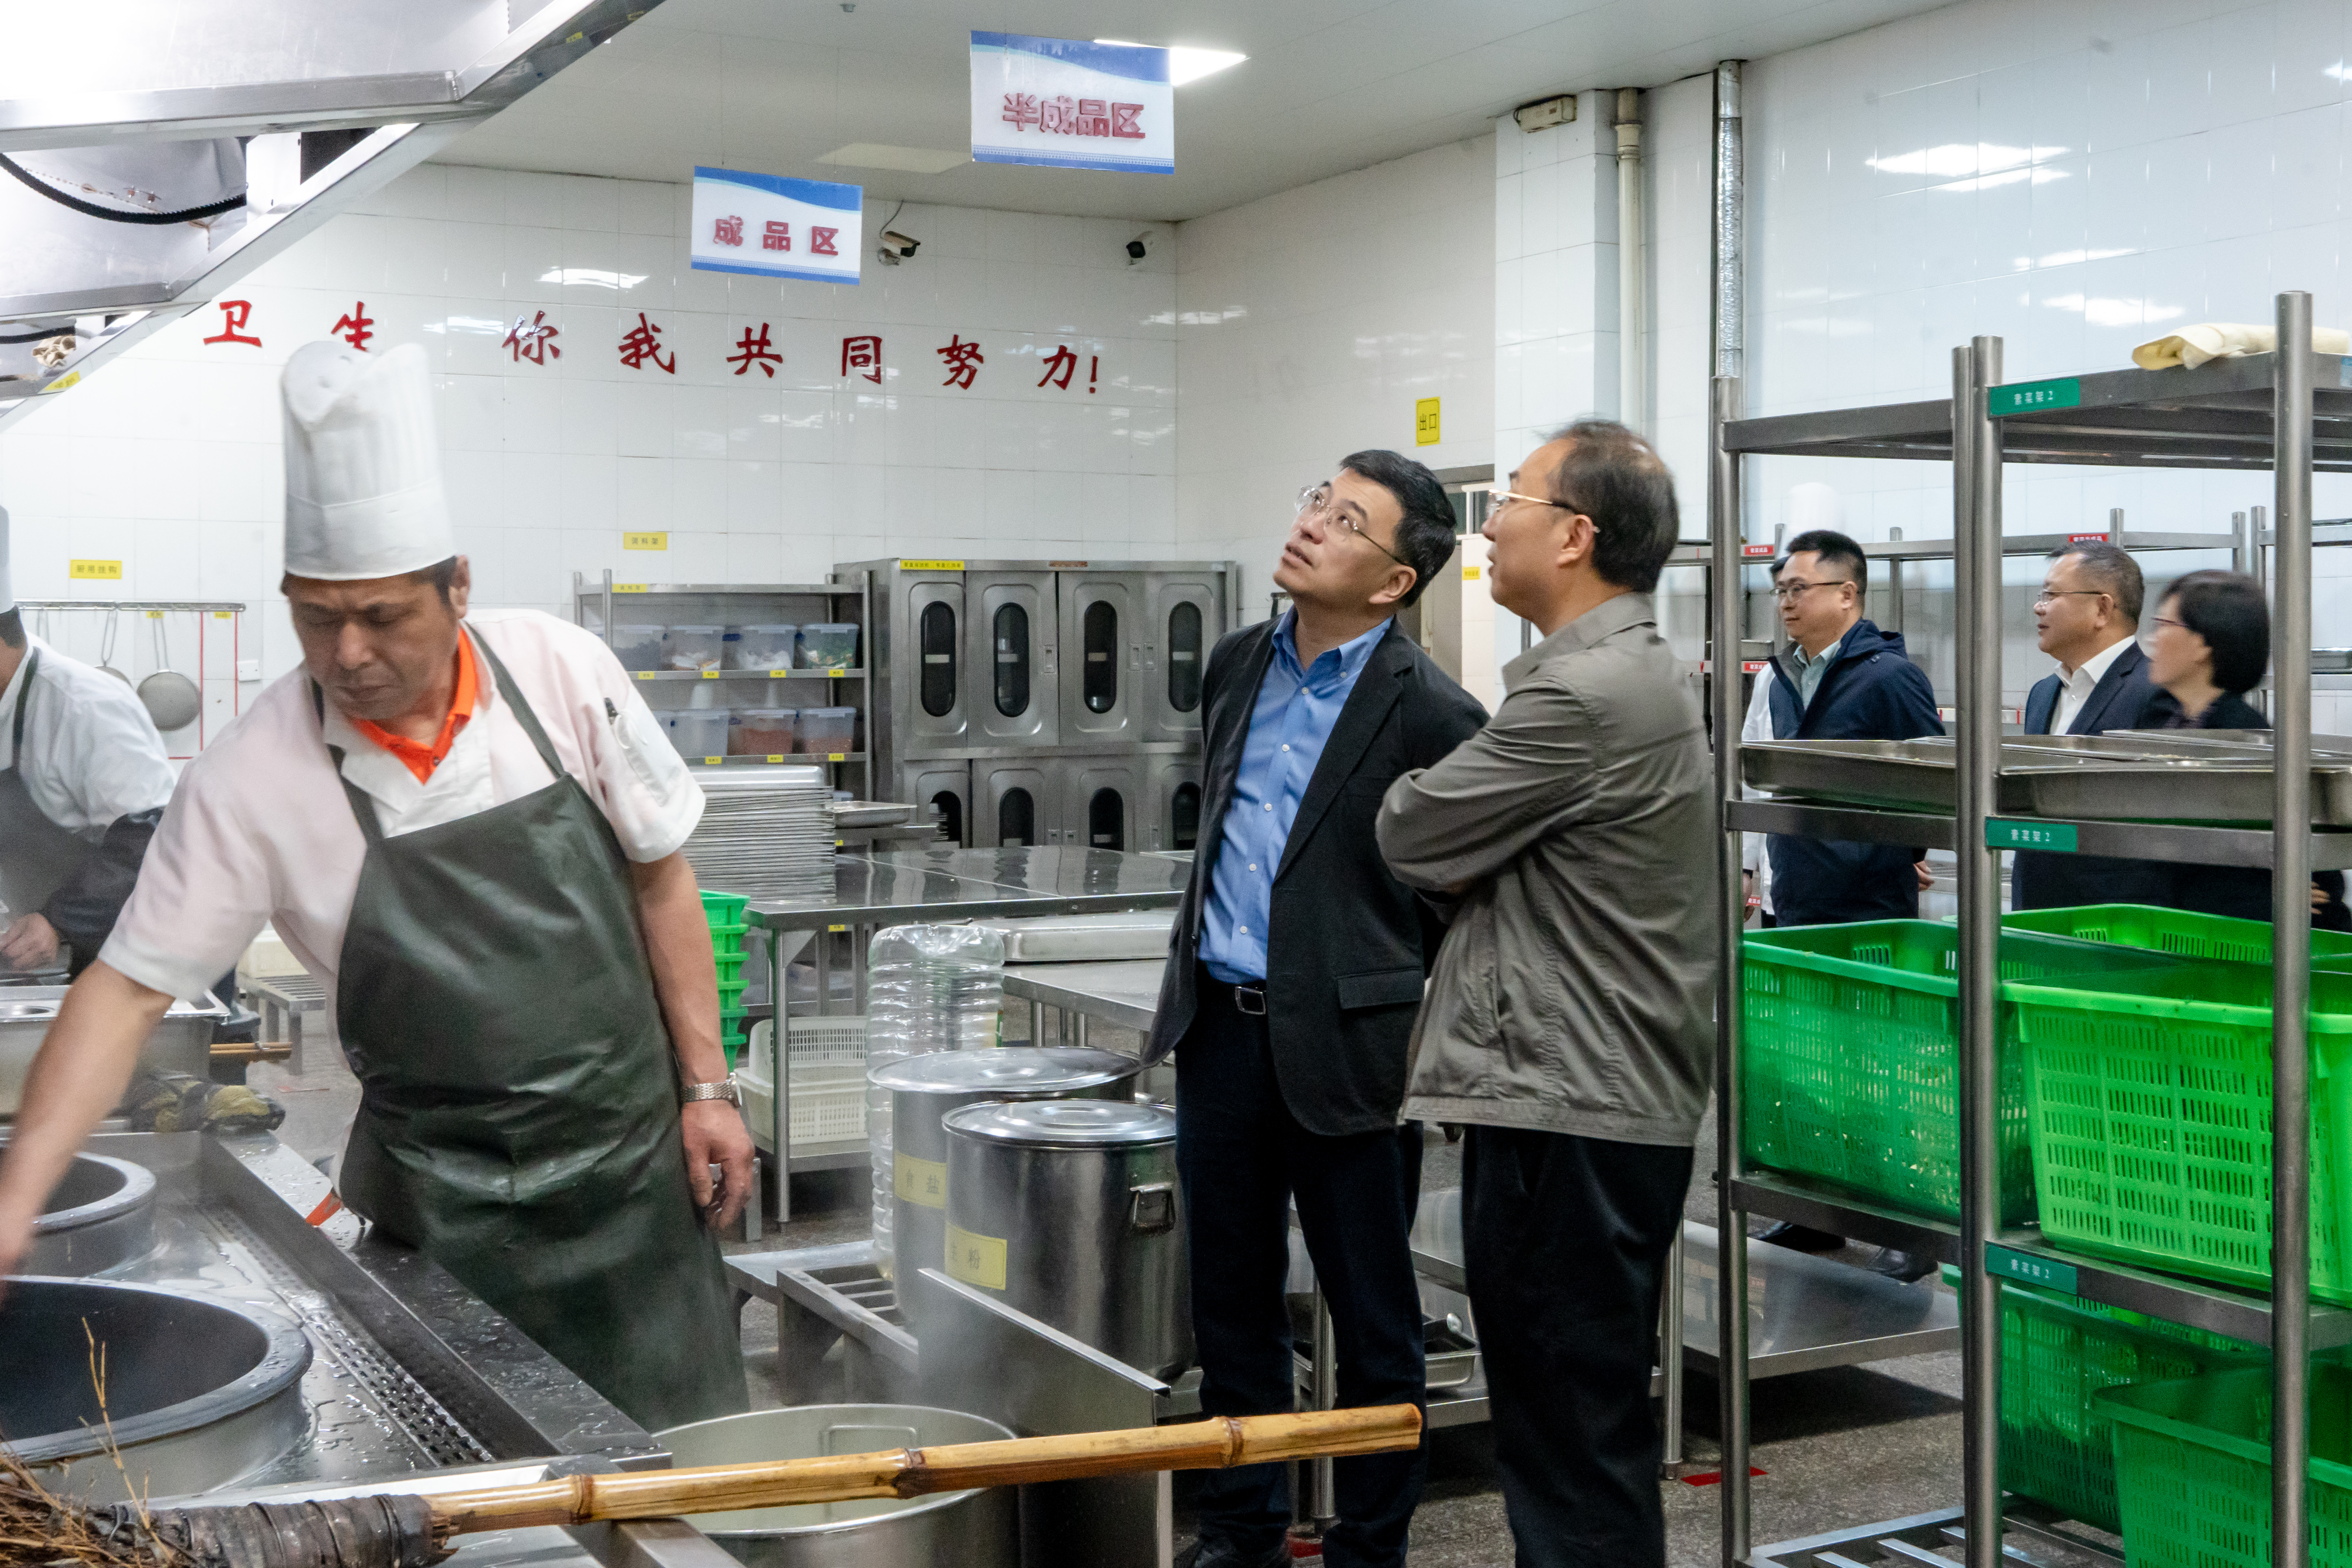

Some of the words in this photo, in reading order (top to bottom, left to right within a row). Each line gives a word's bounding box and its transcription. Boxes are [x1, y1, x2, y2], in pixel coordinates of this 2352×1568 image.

[1003, 93, 1146, 139] 半成品区
[714, 215, 839, 256] 成品区
[1419, 413, 1436, 430] 出口
